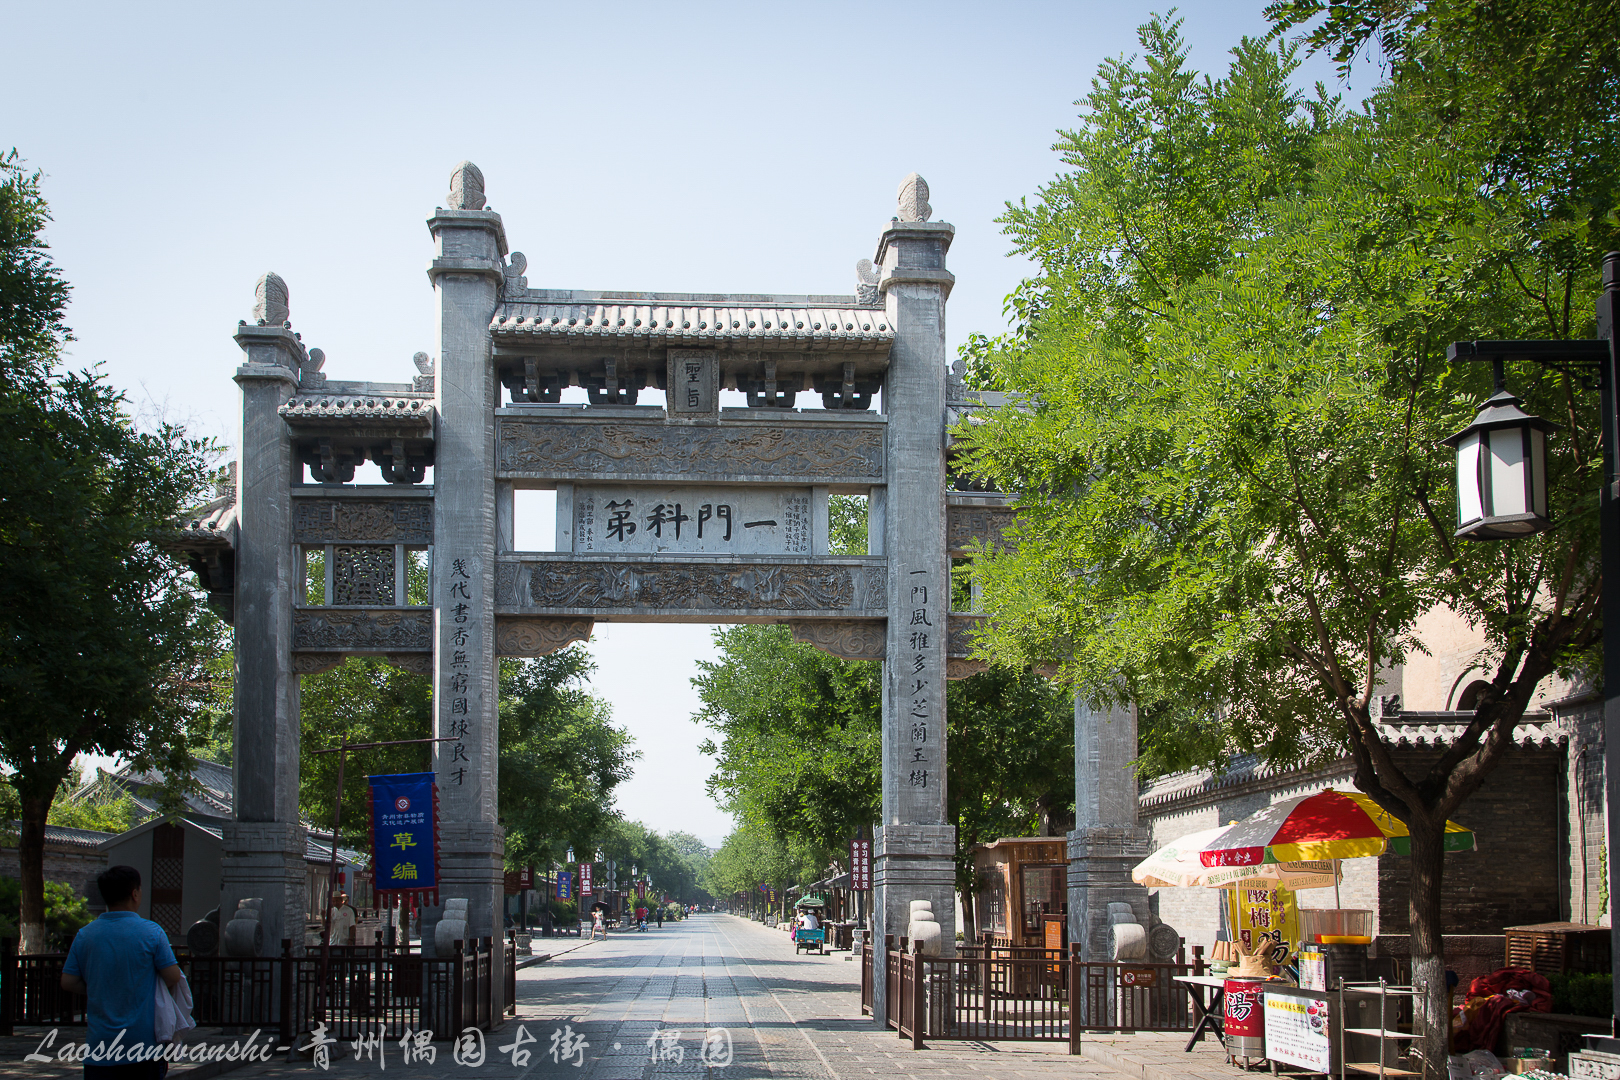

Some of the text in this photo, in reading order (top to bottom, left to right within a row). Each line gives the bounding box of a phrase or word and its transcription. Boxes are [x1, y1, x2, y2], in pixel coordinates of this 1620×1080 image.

[686, 362, 701, 408] 聖旨
[908, 570, 932, 789] 一門風雅多少芝蘭玉樹
[390, 832, 418, 880] 草编
[852, 841, 860, 889] 争当青州好人
[861, 841, 869, 889] 学习道德模范
[1227, 992, 1253, 1021] 湯
